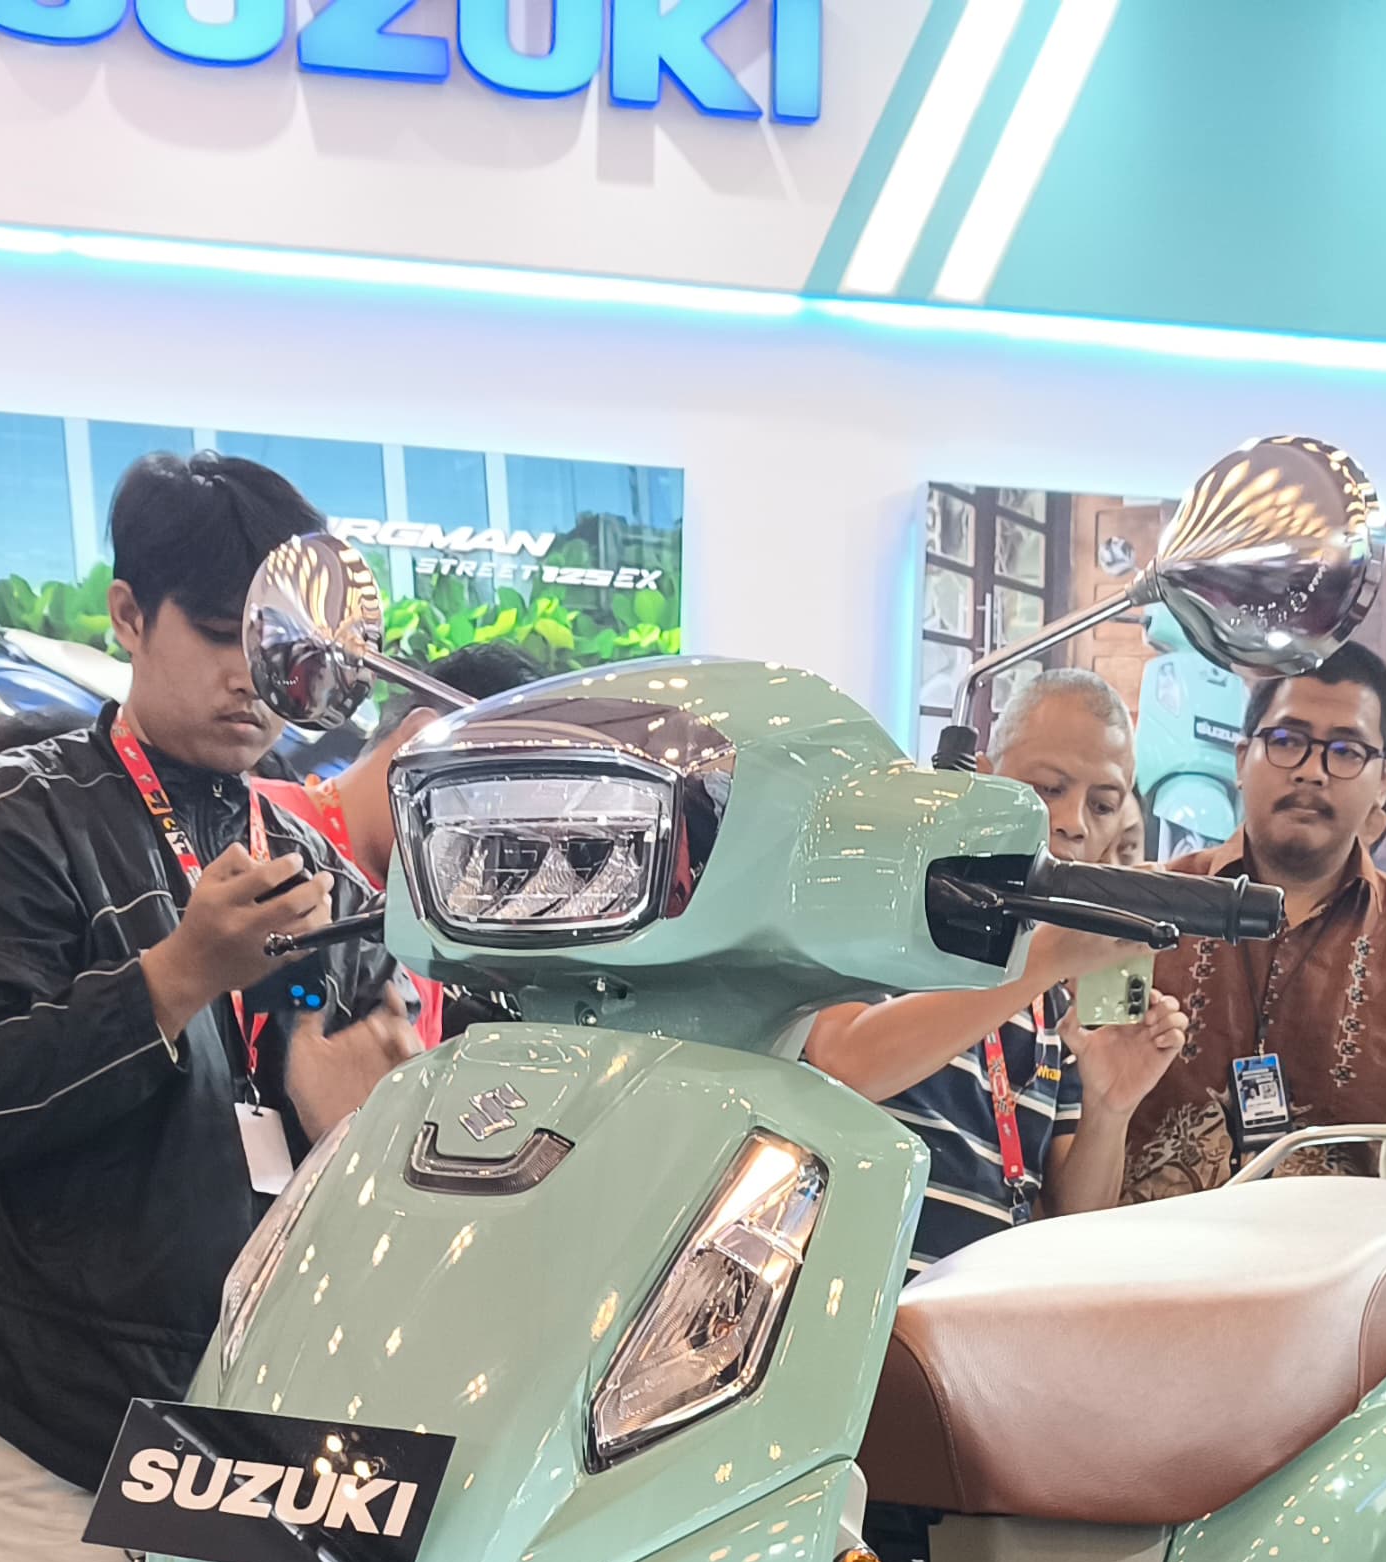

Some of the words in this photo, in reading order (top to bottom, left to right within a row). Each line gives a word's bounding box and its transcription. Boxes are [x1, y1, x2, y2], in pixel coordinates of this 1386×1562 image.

[327, 516, 556, 557] RGMAN
[415, 557, 539, 580] STREET
[541, 565, 614, 587] 125
[613, 567, 662, 589] EX
[121, 1448, 418, 1537] SUZUKI
